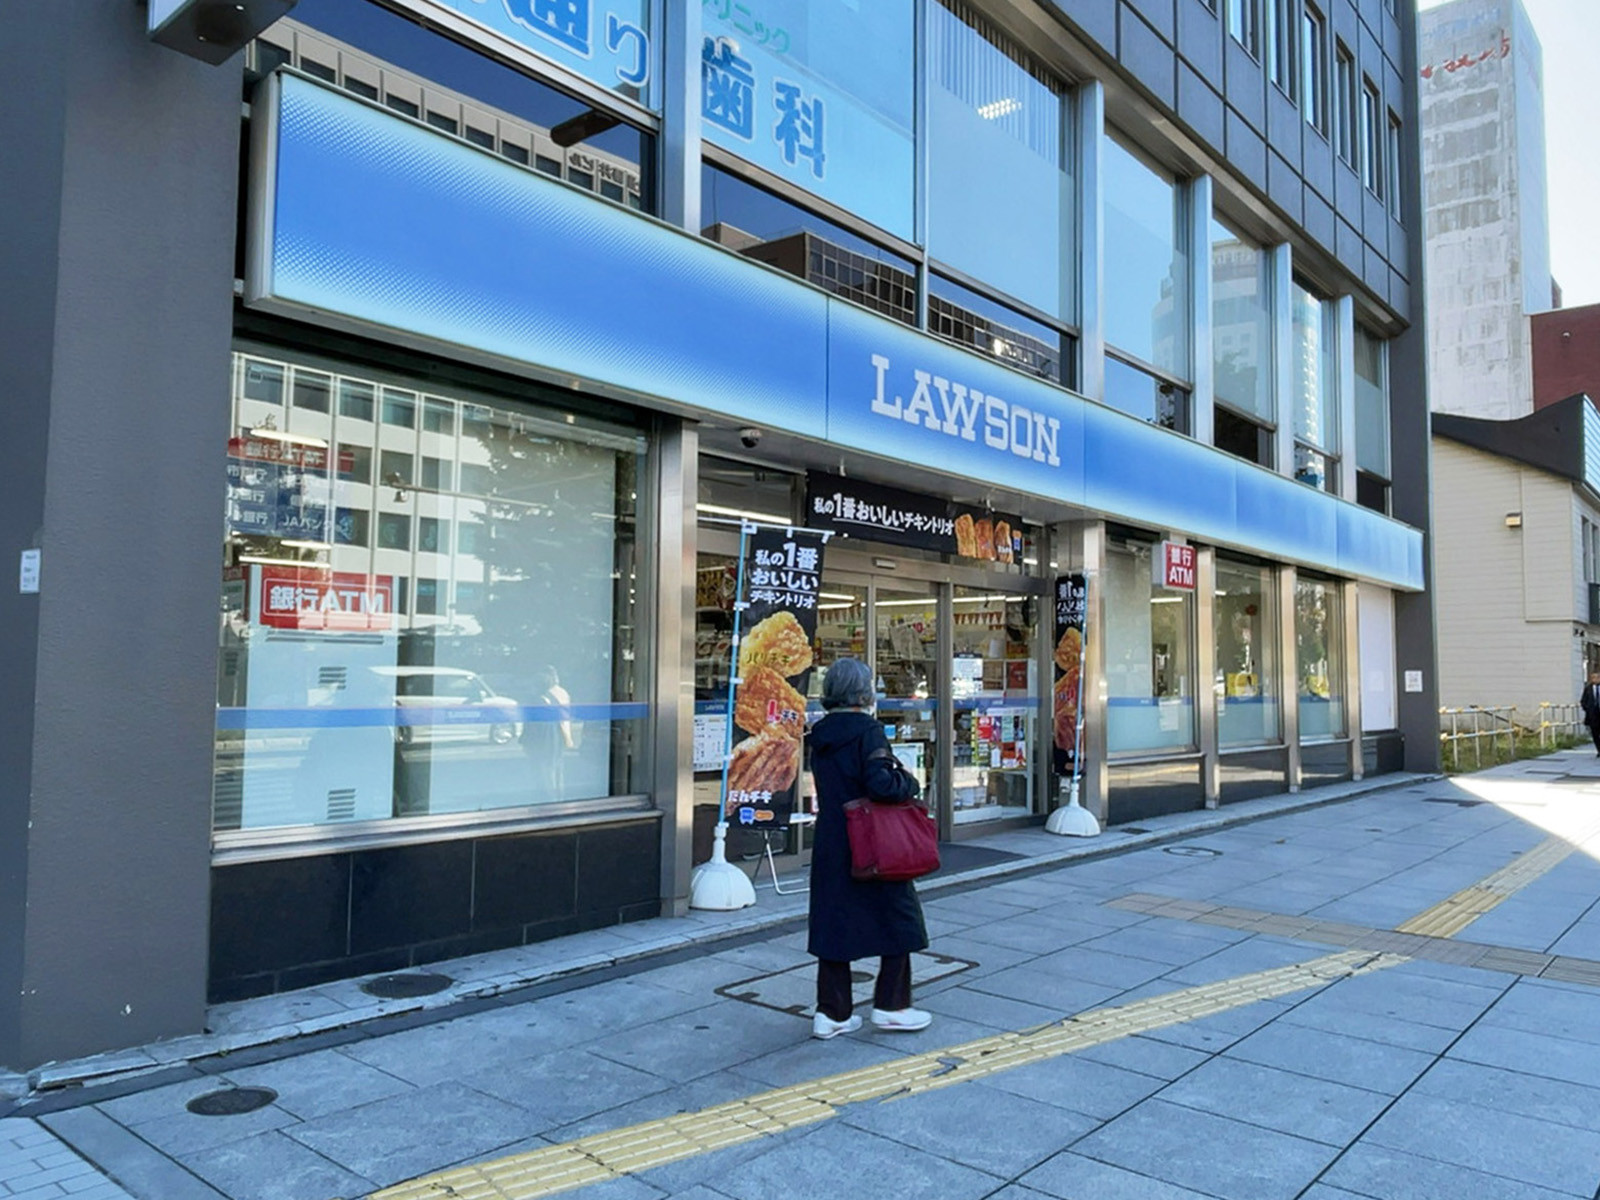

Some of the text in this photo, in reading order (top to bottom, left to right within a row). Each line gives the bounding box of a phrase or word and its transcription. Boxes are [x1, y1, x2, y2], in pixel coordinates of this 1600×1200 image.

[701, 35, 826, 178] 歯科
[871, 353, 1061, 467] LAWSON
[813, 493, 955, 535] 私の1番おいしいチキントリオ
[755, 542, 818, 570] 私の1番
[1170, 547, 1191, 566] 銀行
[751, 568, 818, 590] おいしい
[1169, 565, 1193, 585] ATM
[269, 586, 384, 615] 銀行ATM
[750, 590, 816, 609] チキントリオ
